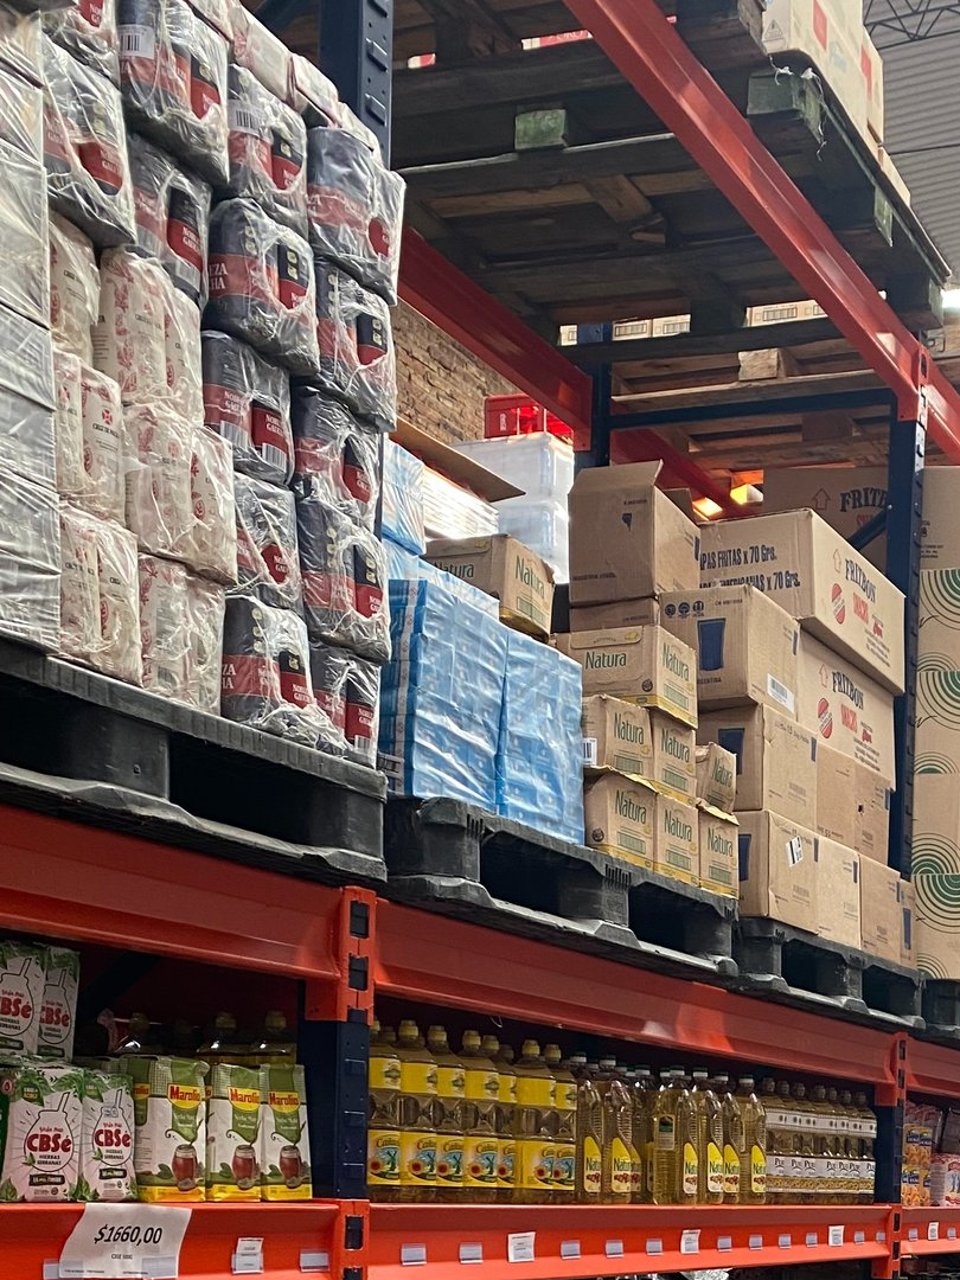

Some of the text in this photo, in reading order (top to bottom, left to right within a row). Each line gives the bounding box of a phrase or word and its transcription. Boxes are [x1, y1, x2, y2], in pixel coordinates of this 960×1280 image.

[717, 549, 742, 568] FRITAS
[750, 545, 760, 562] 70
[515, 554, 545, 599] Natura
[773, 571, 784, 587] 70
[585, 651, 627, 670] Natura
[662, 643, 690, 682] Natura
[614, 713, 644, 745] Natura
[661, 728, 690, 763] Natura
[712, 757, 733, 787] Natura
[615, 789, 647, 825] Natura
[664, 809, 692, 843] Natura
[707, 827, 733, 858] Natura
[26, 1133, 72, 1153] CBSé
[94, 1128, 131, 1148] CBSé
[94, 1224, 163, 1247] $1660,00
